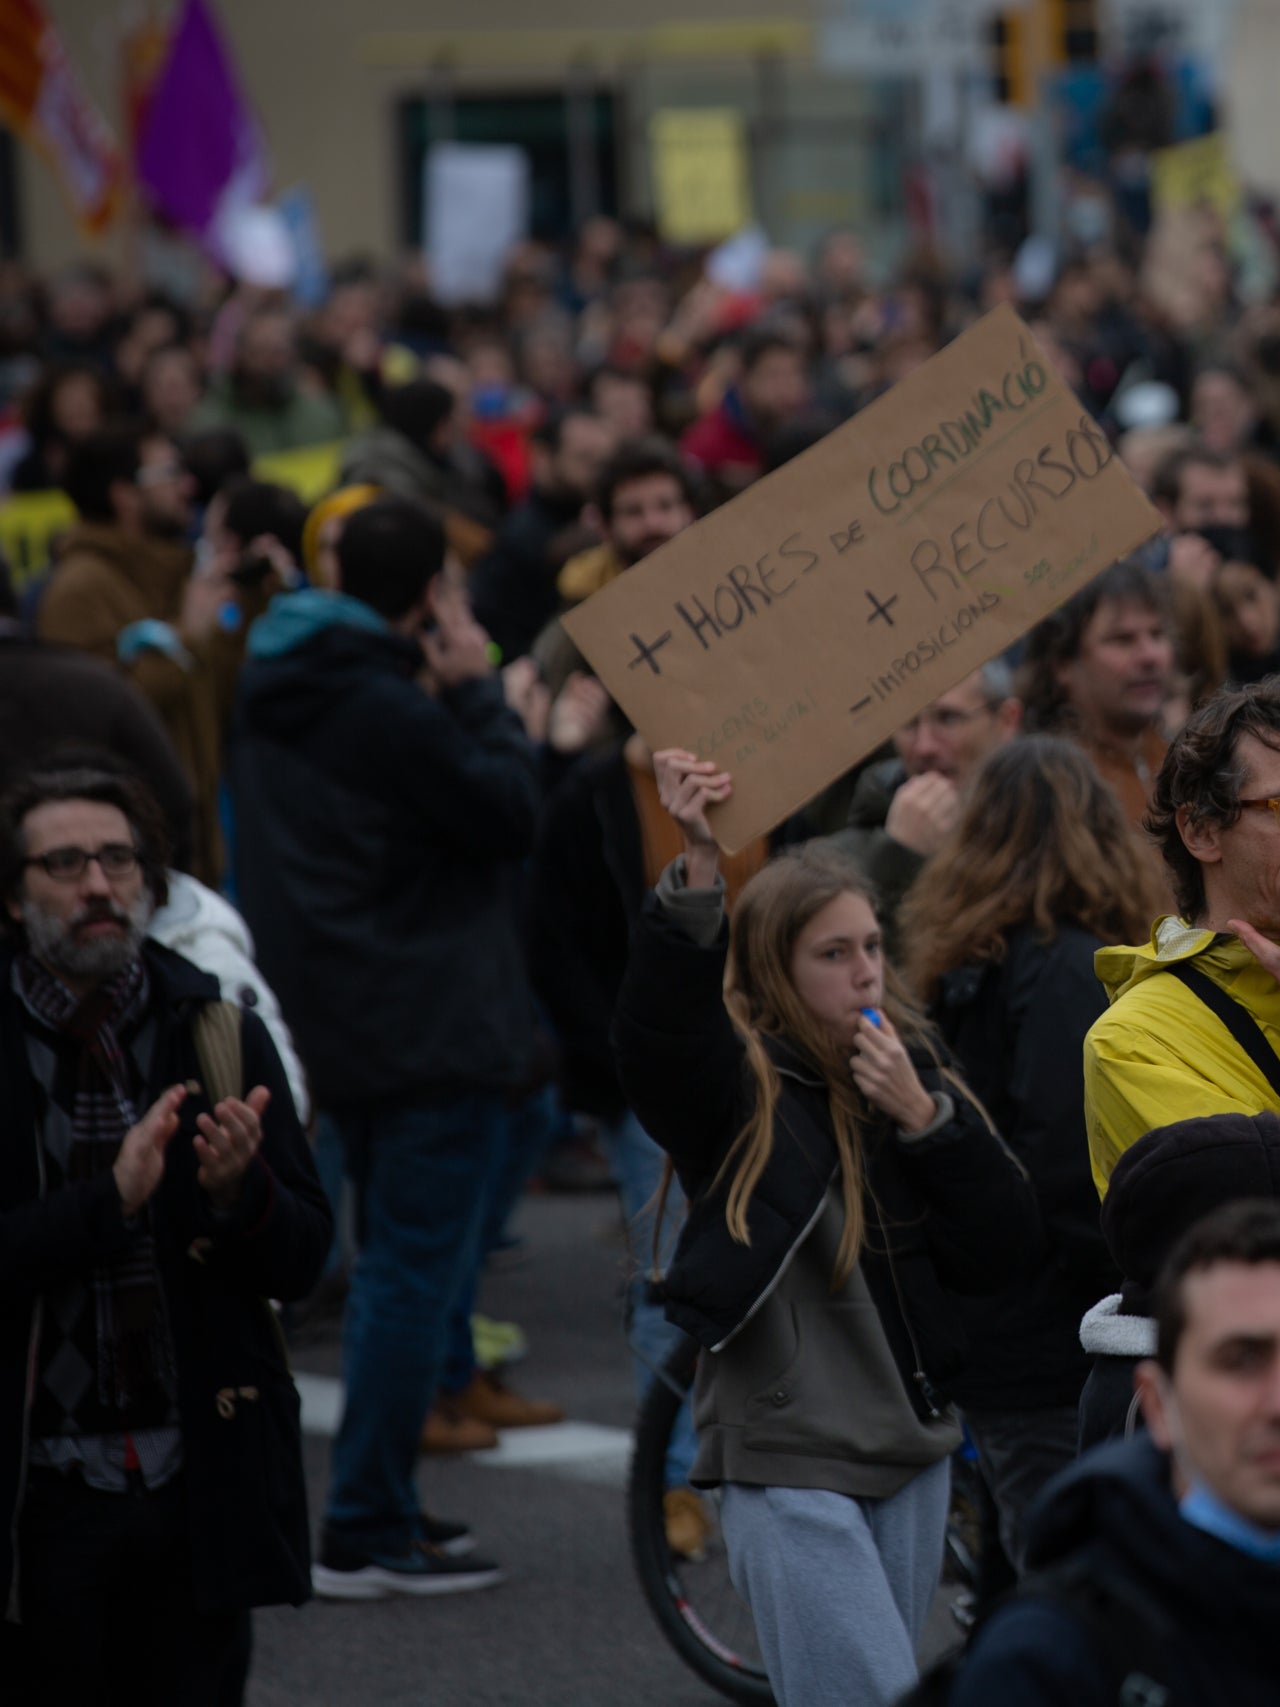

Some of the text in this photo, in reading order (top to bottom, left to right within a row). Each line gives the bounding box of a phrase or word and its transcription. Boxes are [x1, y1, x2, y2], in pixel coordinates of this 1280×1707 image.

[673, 530, 819, 650] HORES
[829, 519, 866, 554] DE
[867, 334, 1047, 515] COORDINACIÓ
[910, 413, 1114, 602] RECURSOS
